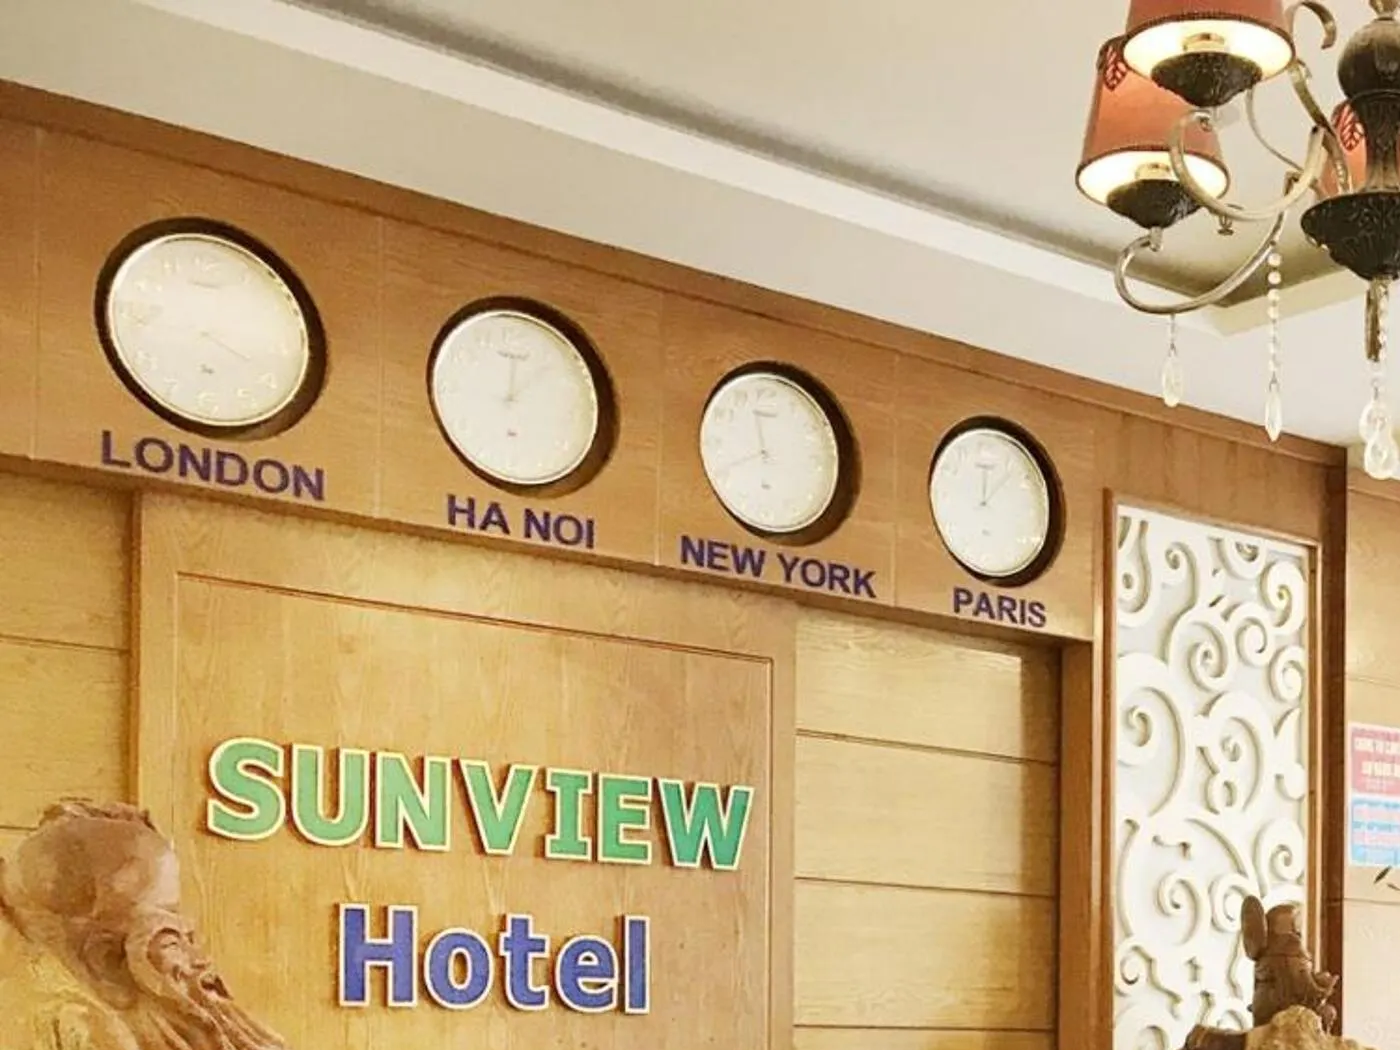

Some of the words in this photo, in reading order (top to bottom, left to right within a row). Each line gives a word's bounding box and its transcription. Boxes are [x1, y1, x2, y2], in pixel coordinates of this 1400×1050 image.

[101, 431, 324, 501] LONDON
[447, 495, 510, 534] HA
[524, 508, 595, 549] NOI
[681, 535, 765, 577] NEW
[778, 552, 876, 598] YORK
[952, 588, 1047, 628] PARIS
[207, 737, 755, 871] SUNVIEW
[338, 903, 651, 1014] Hotel
